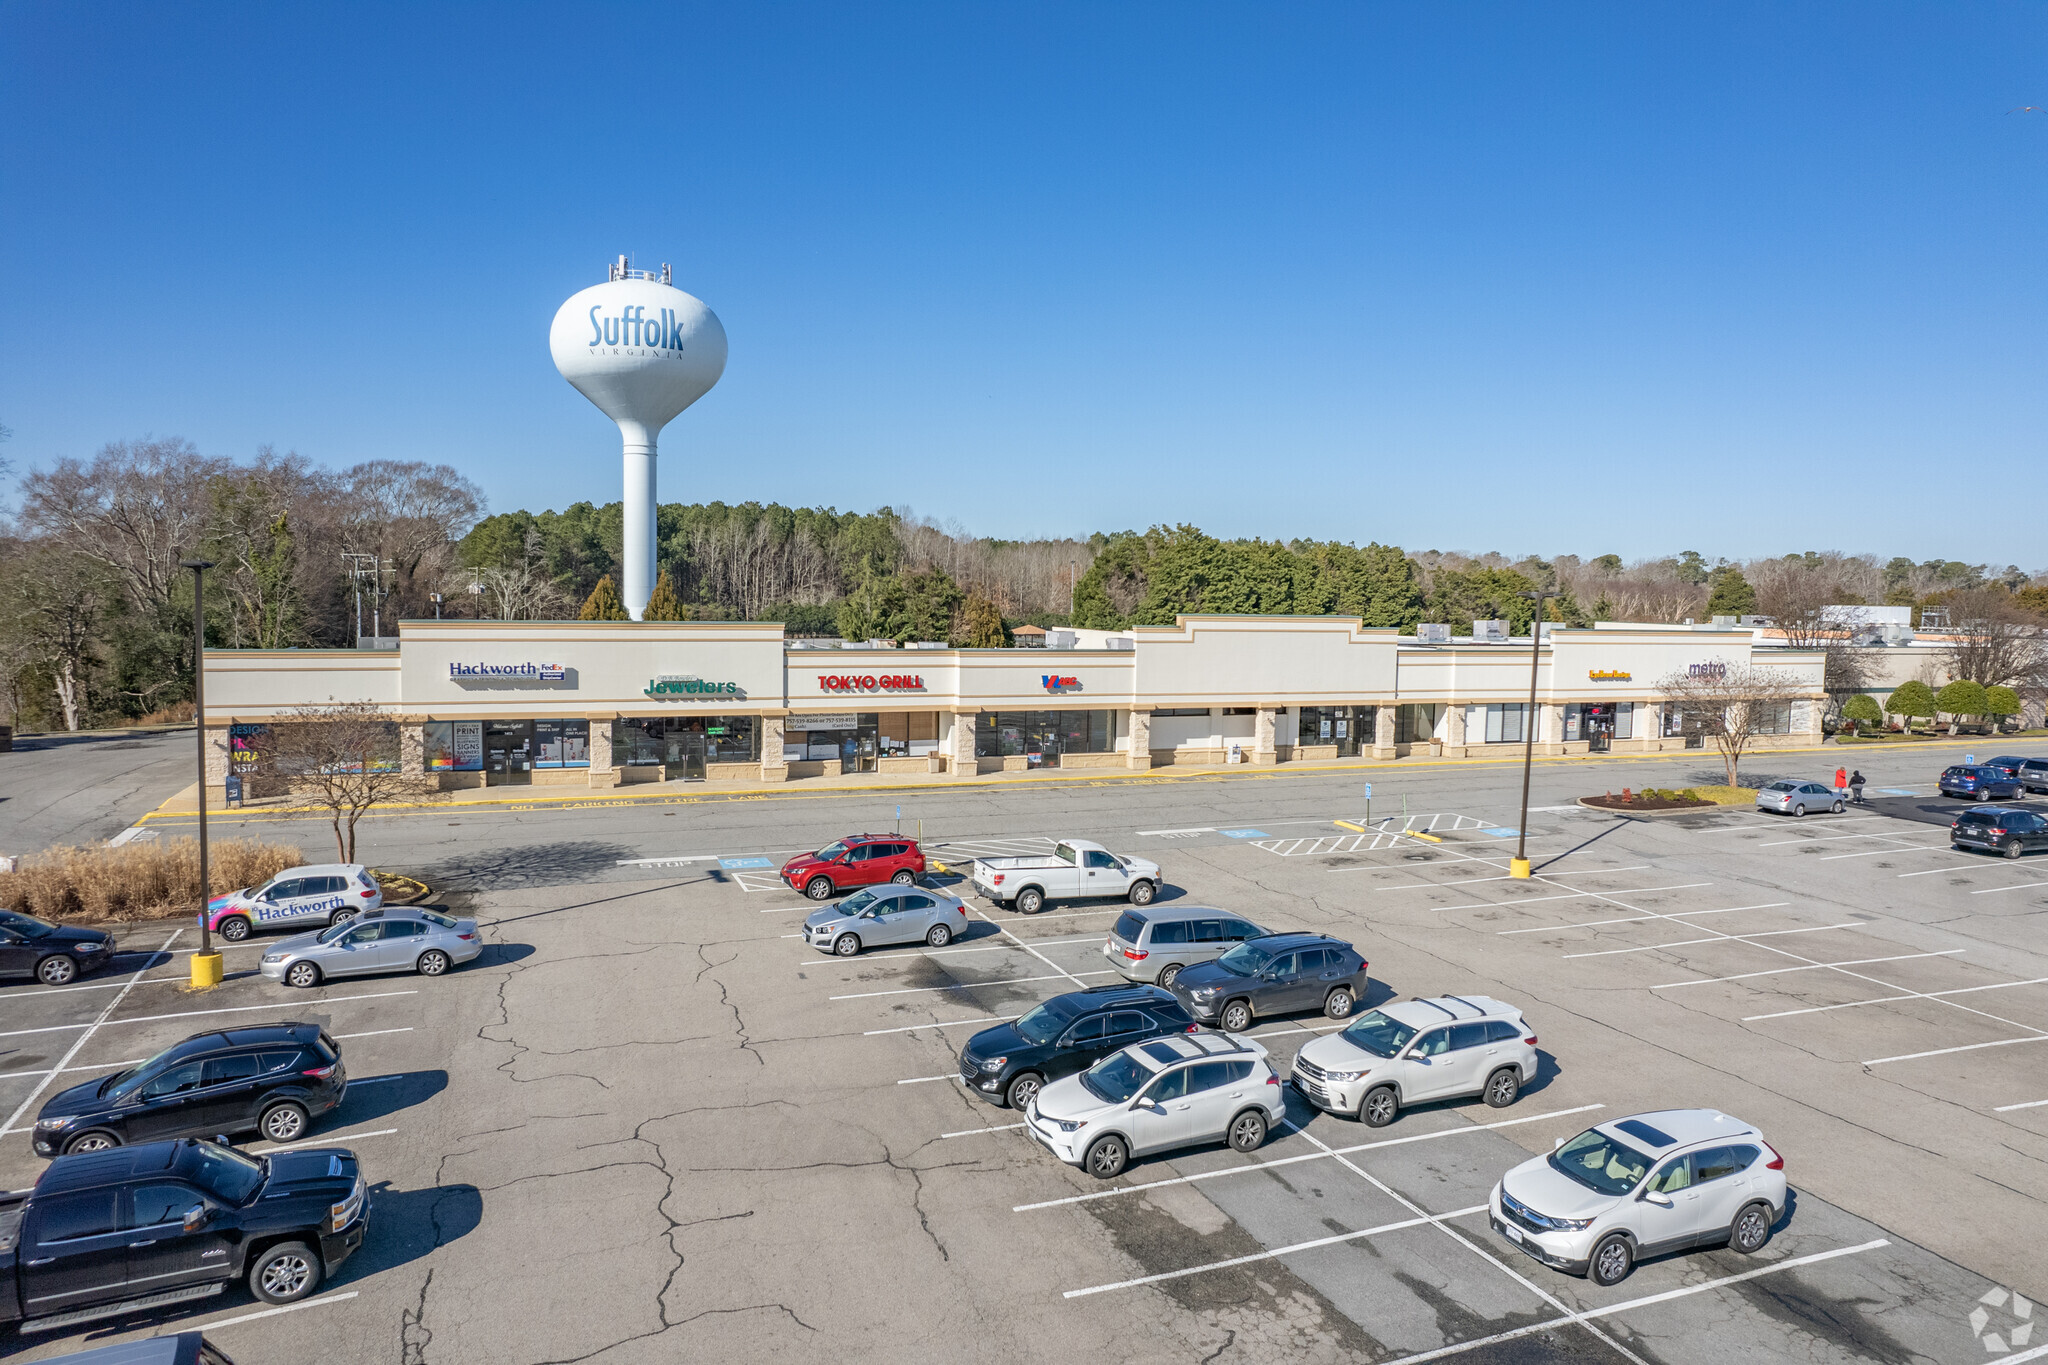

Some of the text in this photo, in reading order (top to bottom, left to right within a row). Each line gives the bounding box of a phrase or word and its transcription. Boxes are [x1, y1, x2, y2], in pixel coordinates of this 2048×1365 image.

[589, 305, 684, 351] Suffolk
[589, 348, 683, 360] VIRGINIA
[450, 662, 537, 675] Hackworth
[541, 663, 563, 671] FedEx
[1689, 661, 1726, 675] metro
[643, 679, 737, 695] Jewelers
[818, 675, 923, 690] TOKYO GRILL
[1057, 676, 1077, 686] ABC
[561, 800, 636, 809] PARKING
[638, 861, 692, 869] STOP
[258, 896, 345, 921] Hackworth
